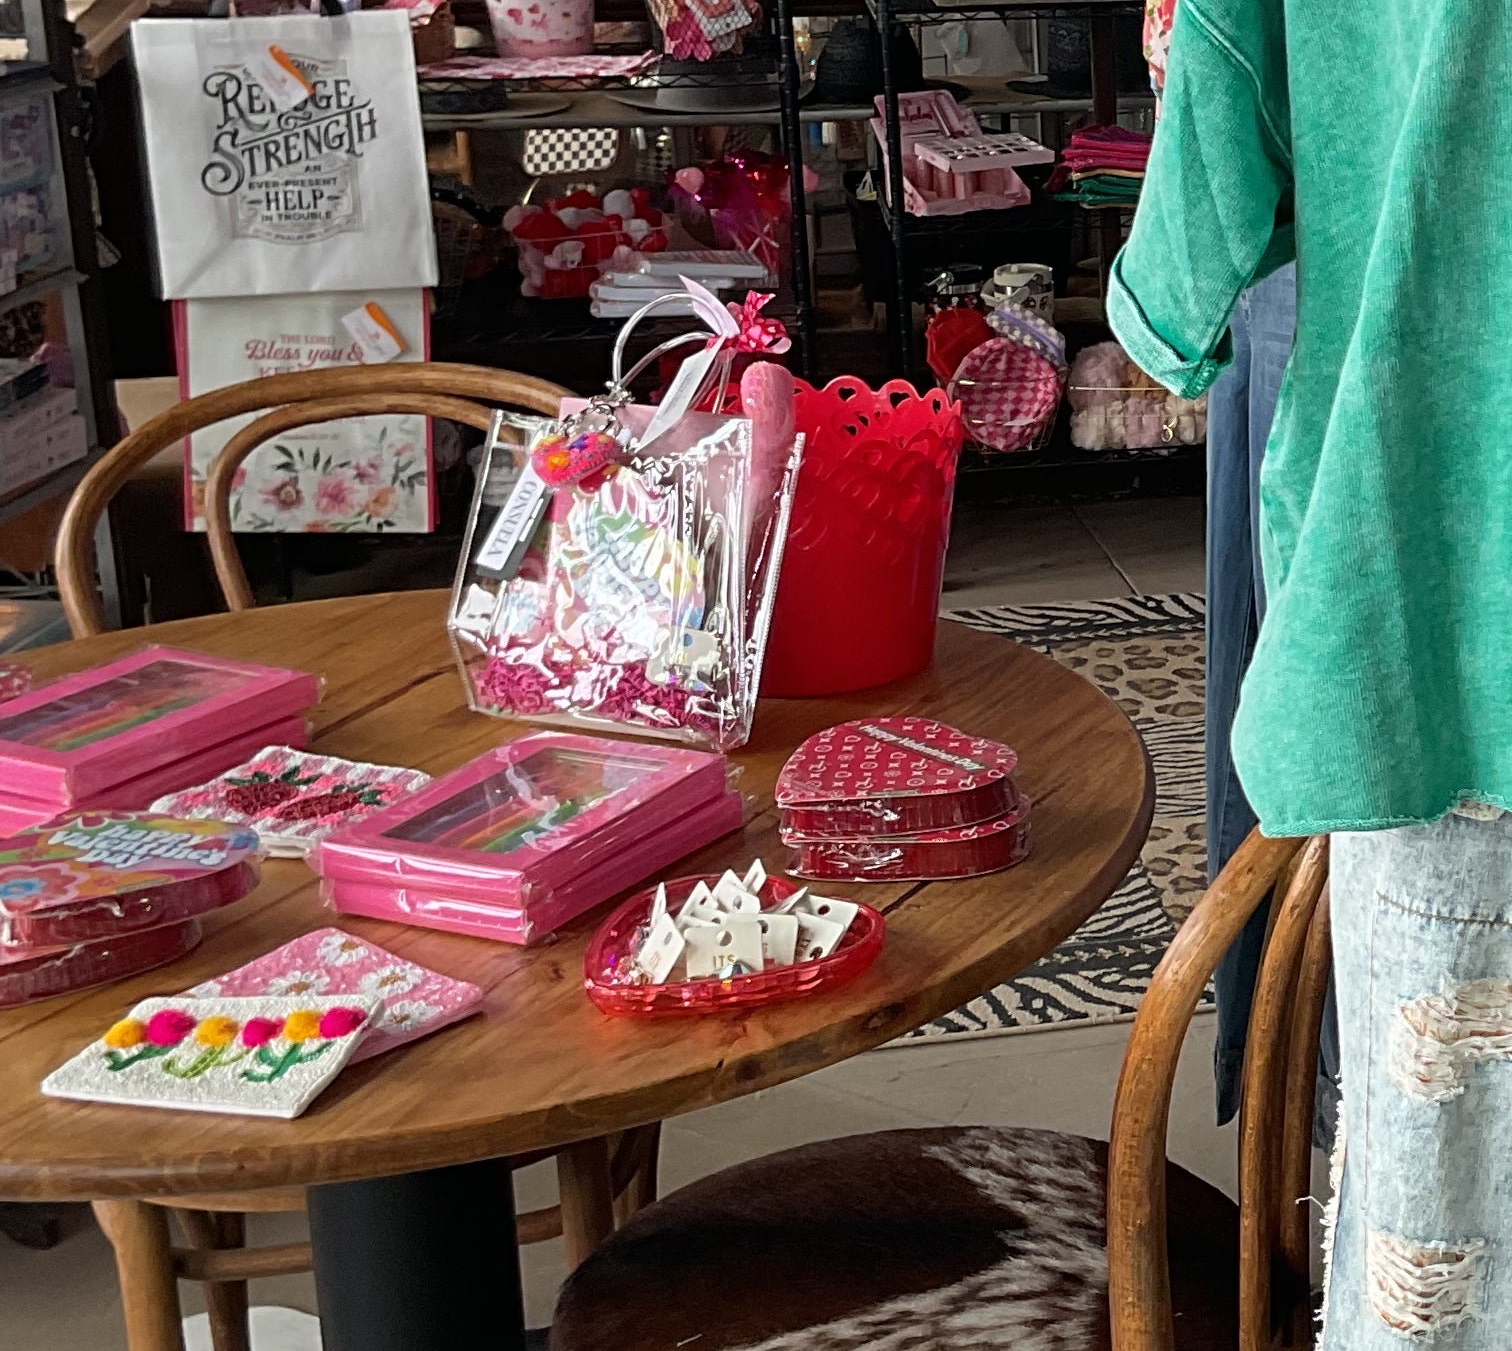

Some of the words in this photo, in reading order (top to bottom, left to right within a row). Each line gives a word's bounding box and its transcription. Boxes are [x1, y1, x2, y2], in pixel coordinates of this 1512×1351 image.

[203, 71, 357, 132] REGE
[201, 107, 378, 196] STRENGTH
[304, 164, 322, 173] AN
[248, 176, 338, 190] EVER-PRESENT
[265, 188, 325, 211] HELP
[261, 213, 274, 222] IN
[277, 210, 332, 223] TROUBLE
[281, 333, 301, 344] THE
[244, 338, 301, 361] Bless
[298, 344, 343, 369] you
[486, 479, 539, 558] CONSUELA
